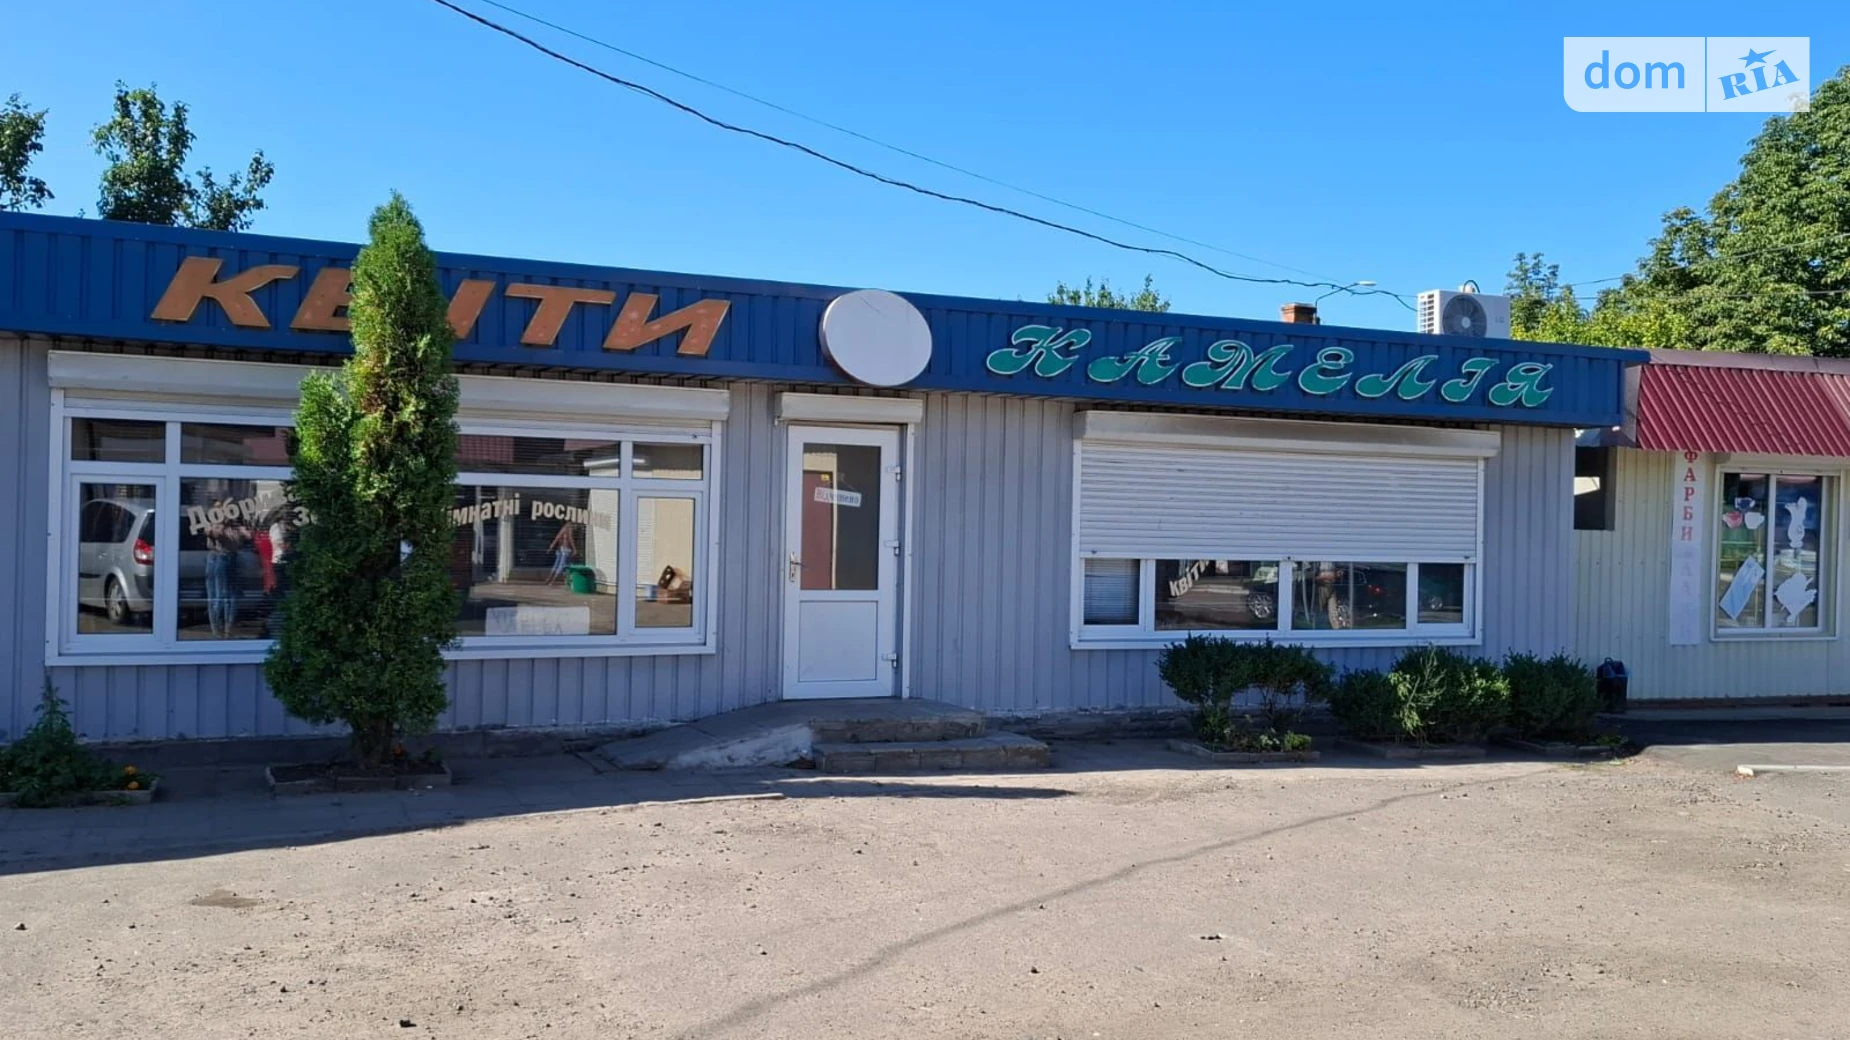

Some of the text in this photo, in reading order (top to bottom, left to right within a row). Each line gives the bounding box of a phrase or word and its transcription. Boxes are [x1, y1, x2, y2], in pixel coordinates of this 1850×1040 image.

[986, 324, 1554, 407] КАМЕЛІЯ
[446, 493, 519, 527] імнатні
[1680, 450, 1698, 541] ФАРБИ
